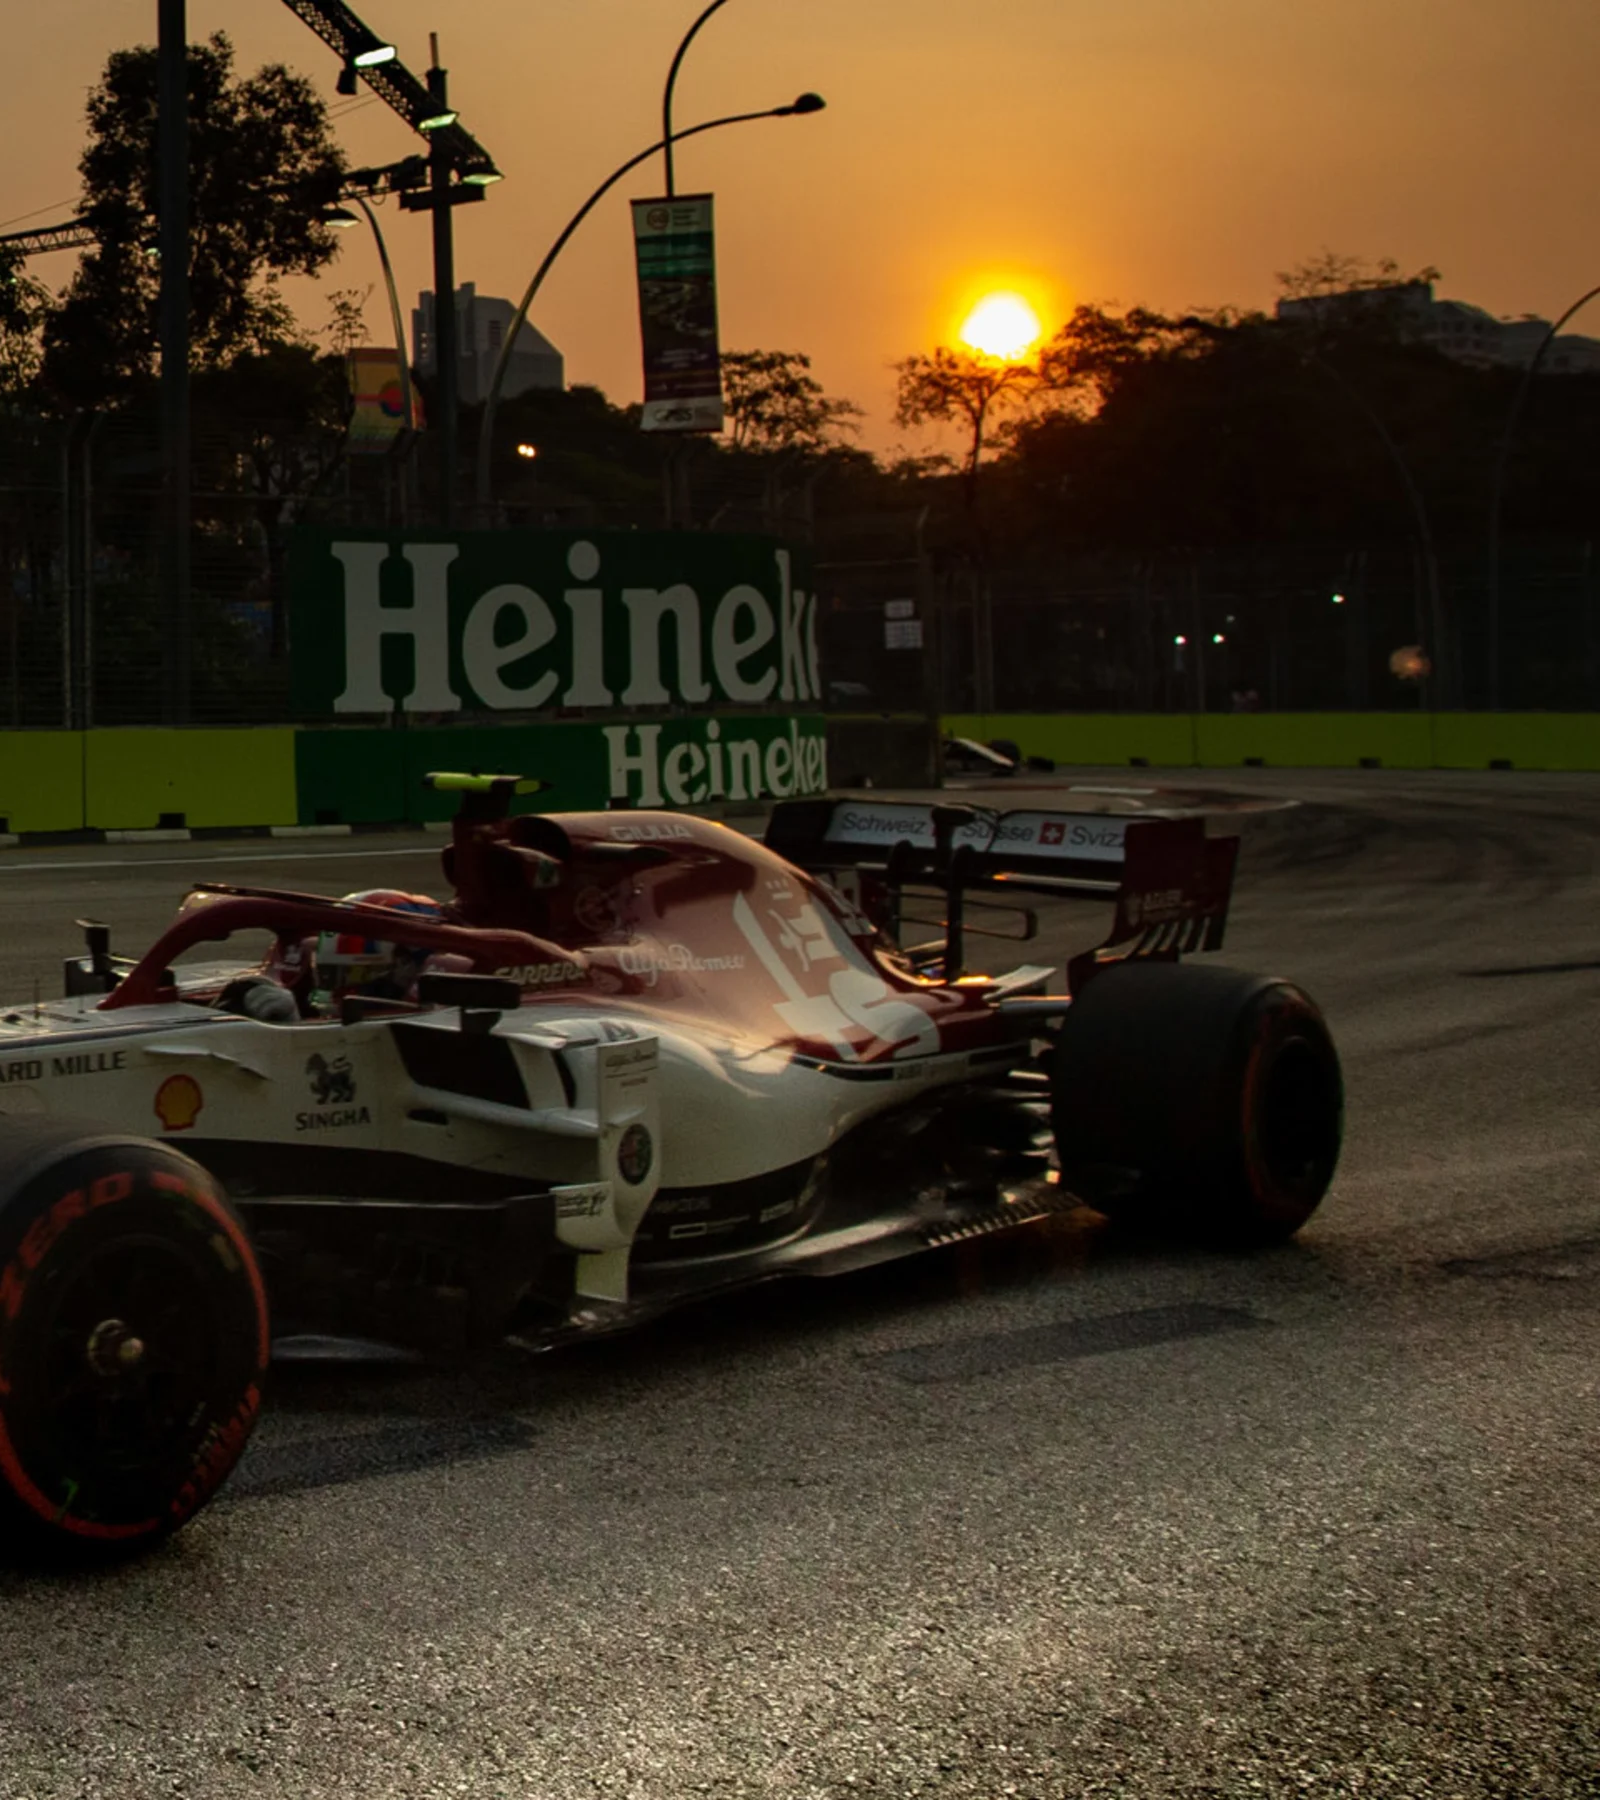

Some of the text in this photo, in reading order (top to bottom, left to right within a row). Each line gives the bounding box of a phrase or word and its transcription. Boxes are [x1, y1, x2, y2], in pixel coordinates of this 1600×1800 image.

[842, 812, 926, 834] Schweiz
[493, 960, 587, 986] CARRERA
[616, 948, 672, 987] Alfa
[52, 1051, 126, 1077] MILLE
[295, 1106, 371, 1131] SINGHA
